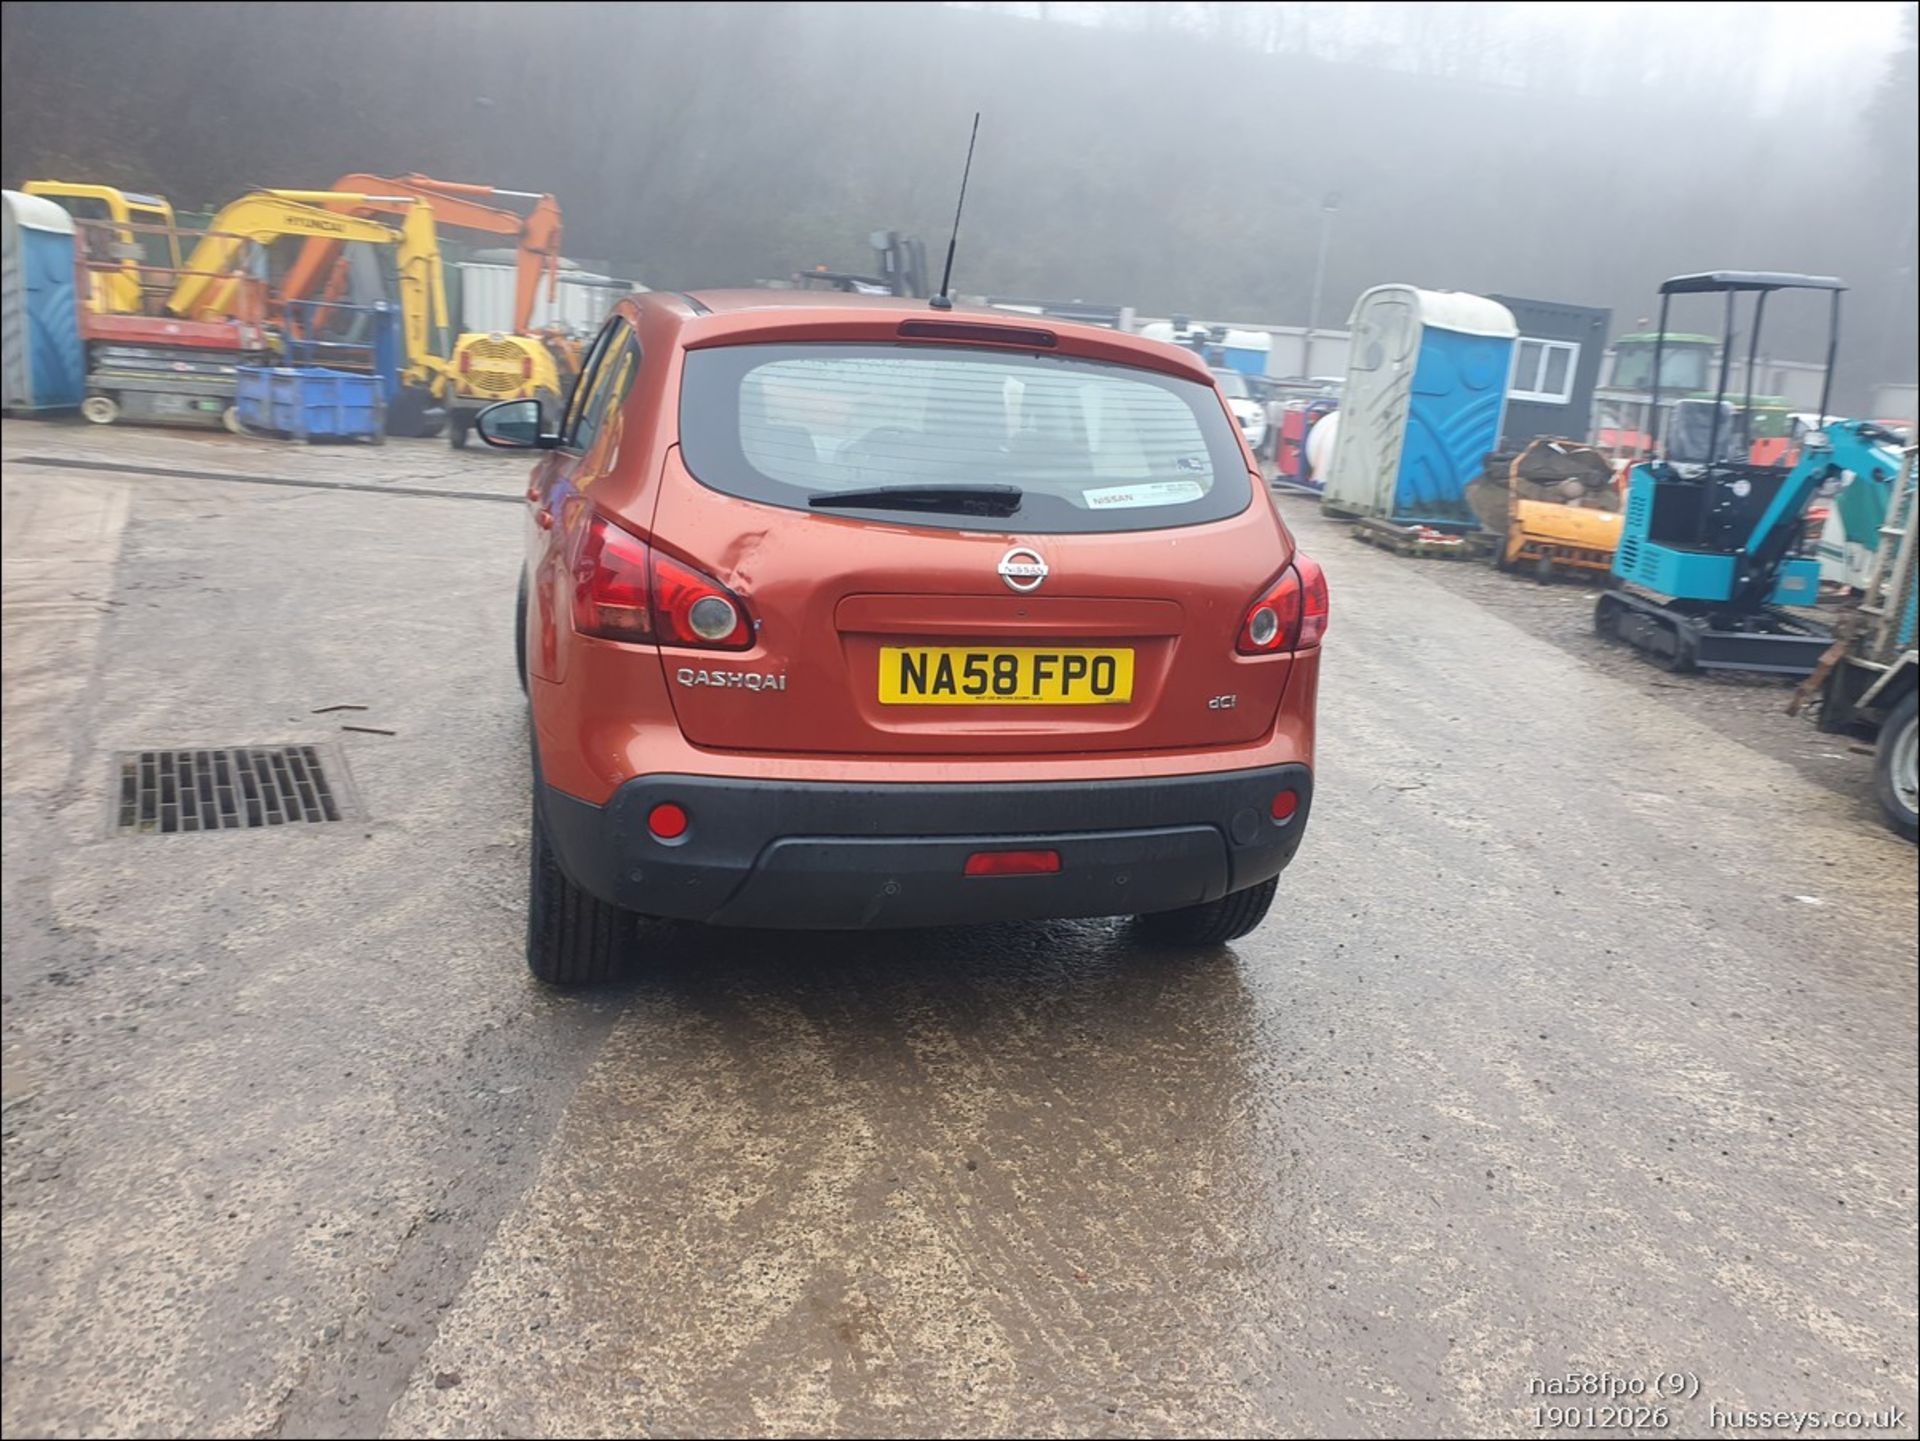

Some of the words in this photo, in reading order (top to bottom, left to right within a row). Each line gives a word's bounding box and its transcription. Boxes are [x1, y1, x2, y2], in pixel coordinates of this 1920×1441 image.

[1093, 494, 1133, 505] NISSAN
[1004, 565, 1044, 575] NISSAN
[900, 652, 1018, 695] NA58
[1032, 654, 1116, 696] FPO
